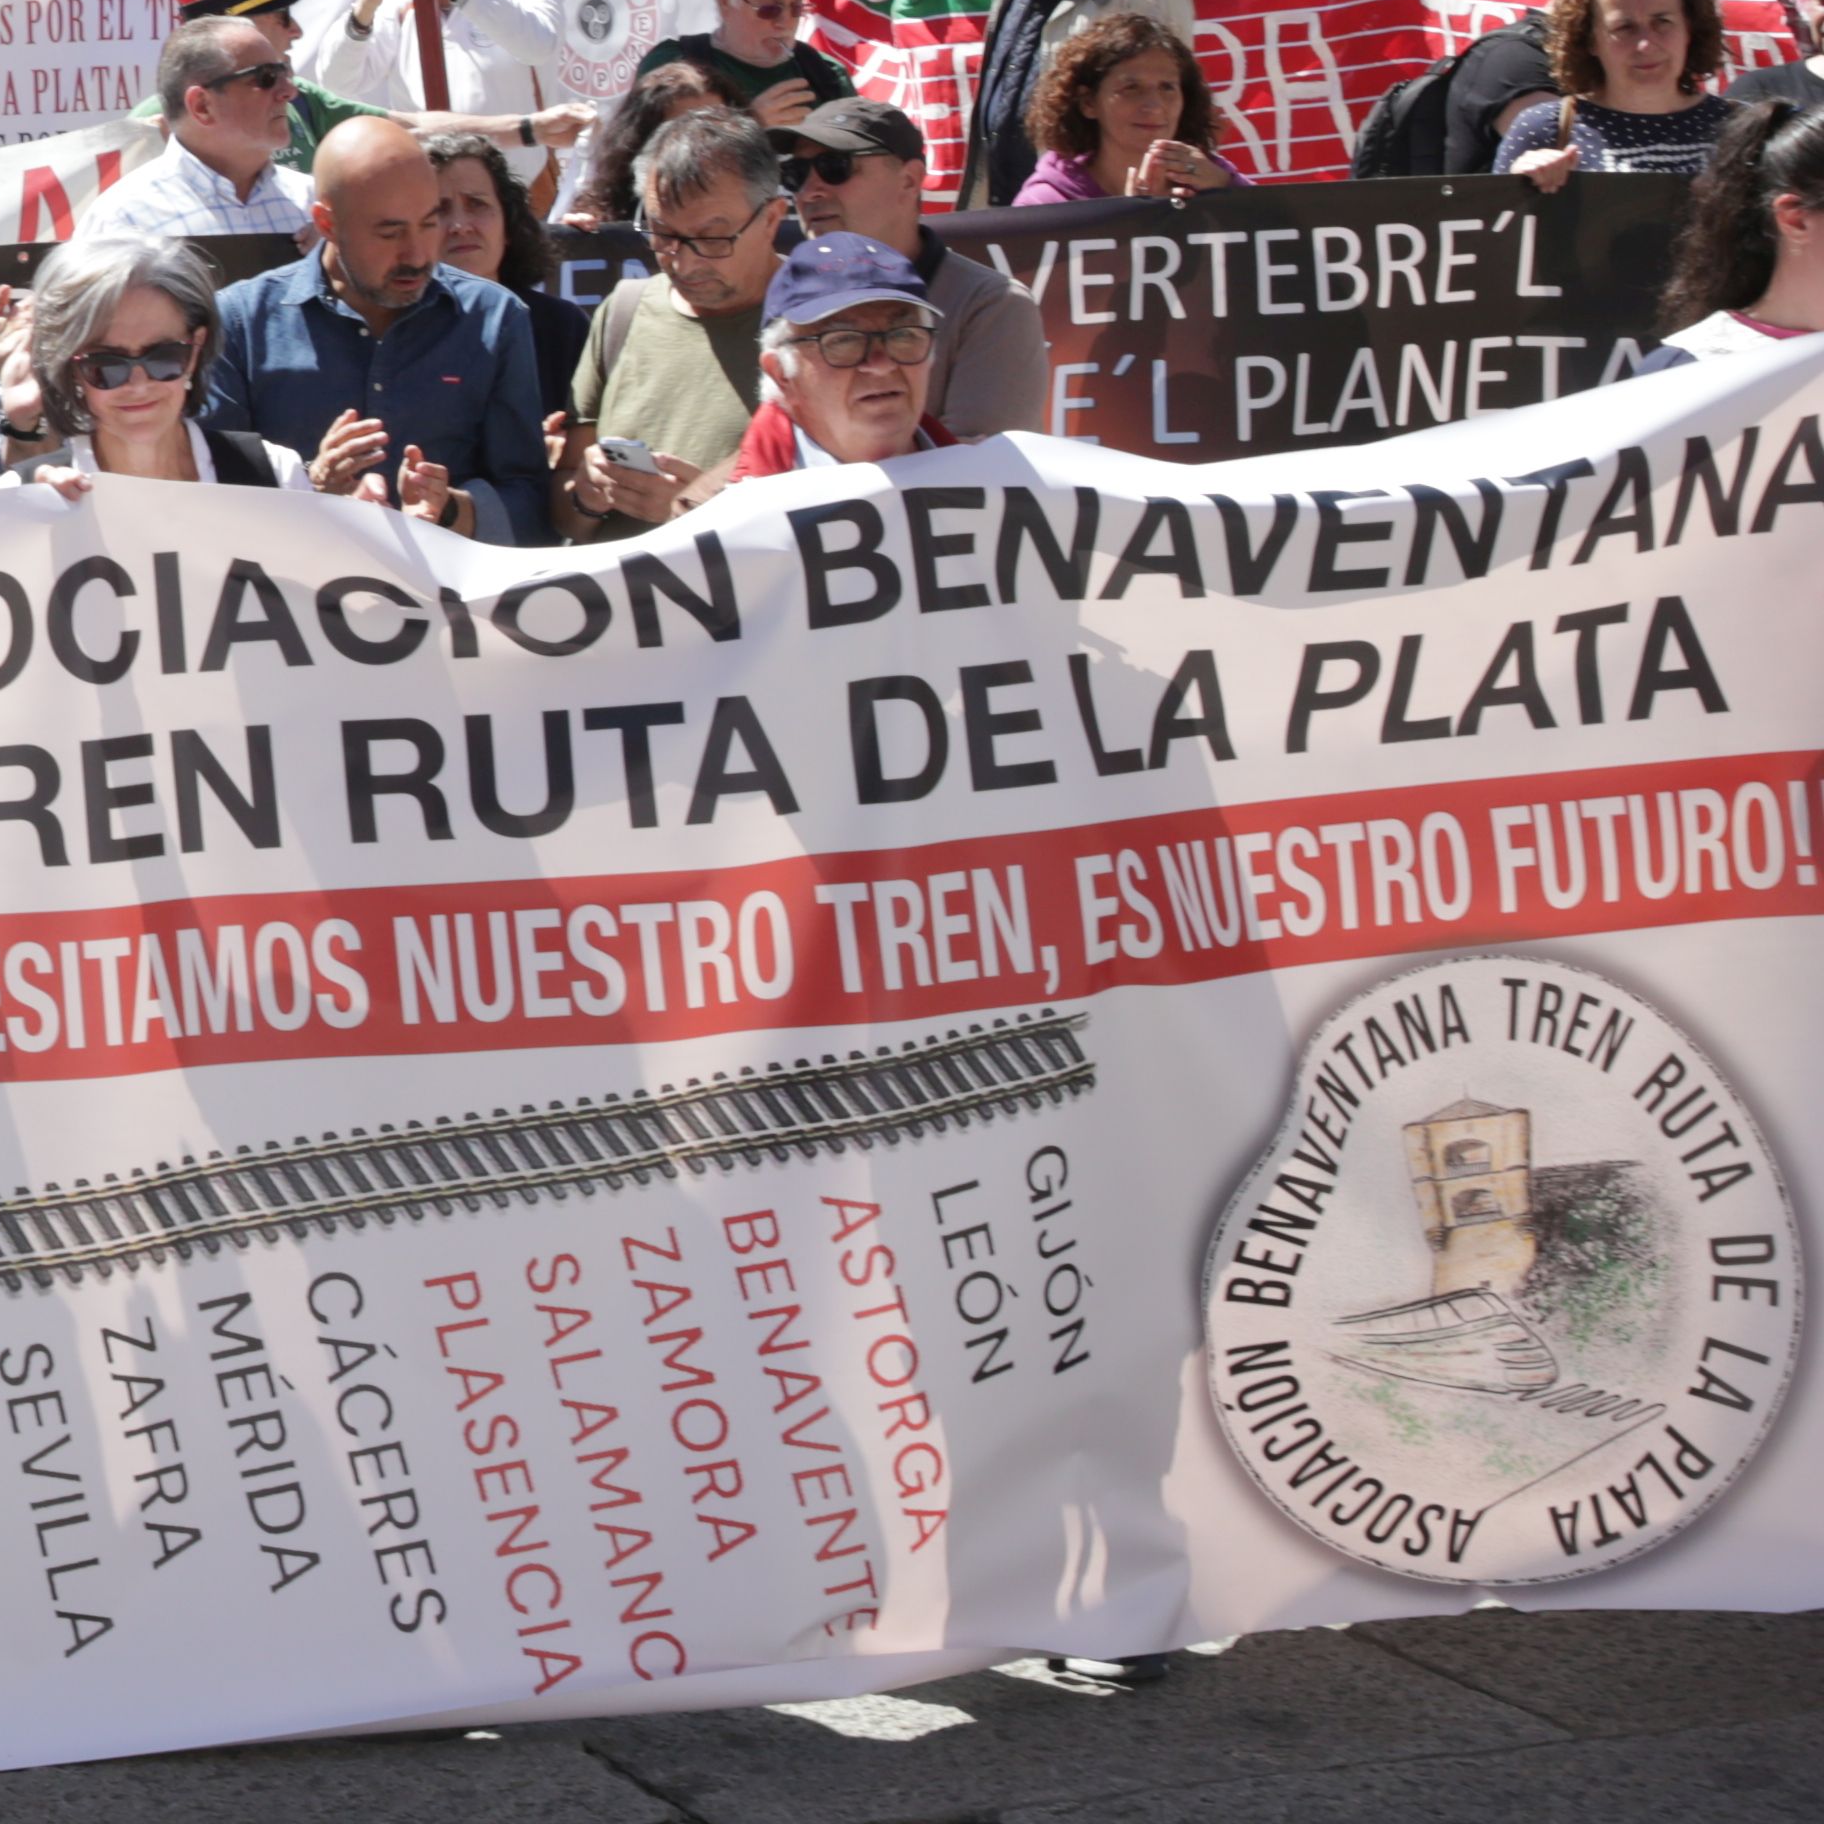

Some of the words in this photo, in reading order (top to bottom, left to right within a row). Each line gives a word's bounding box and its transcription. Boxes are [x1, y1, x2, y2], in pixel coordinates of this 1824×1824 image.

[31, 63, 142, 115] PLATA!
[786, 413, 1824, 632] BENAVENTANA
[338, 694, 800, 844] RUTA
[846, 659, 1059, 807] DE
[1068, 648, 1239, 780] LA
[1284, 594, 1731, 756] PLATA
[390, 888, 793, 1026] NUESTRO
[817, 863, 1060, 996] TREN,
[1075, 845, 1164, 966] ES
[1156, 810, 1473, 950] NUESTRO
[1489, 778, 1818, 916] FUTURO!
[1501, 977, 1636, 1073] TREN
[1224, 982, 1472, 1310] BENAVENTANA
[1632, 1052, 1753, 1203] RUTA
[819, 1194, 950, 1554] ASTORGA
[929, 1179, 1020, 1385] LEÓN
[1024, 1144, 1097, 1377] GIJÓN
[1687, 1335, 1772, 1415] LA
[1709, 1232, 1781, 1309] DE
[99, 1315, 203, 1570] ZAFRA
[197, 1290, 322, 1594] MÉRIDA
[307, 1271, 447, 1634] CÁCERES
[422, 1270, 584, 1696] PLASENCIA
[525, 1252, 688, 1682] SALAMANC
[621, 1226, 759, 1563] ZAMORA
[722, 1207, 882, 1639] BENAVENTE
[1224, 1339, 1489, 1565] ASOCIACIÓN
[1548, 1425, 1716, 1557] PLATA
